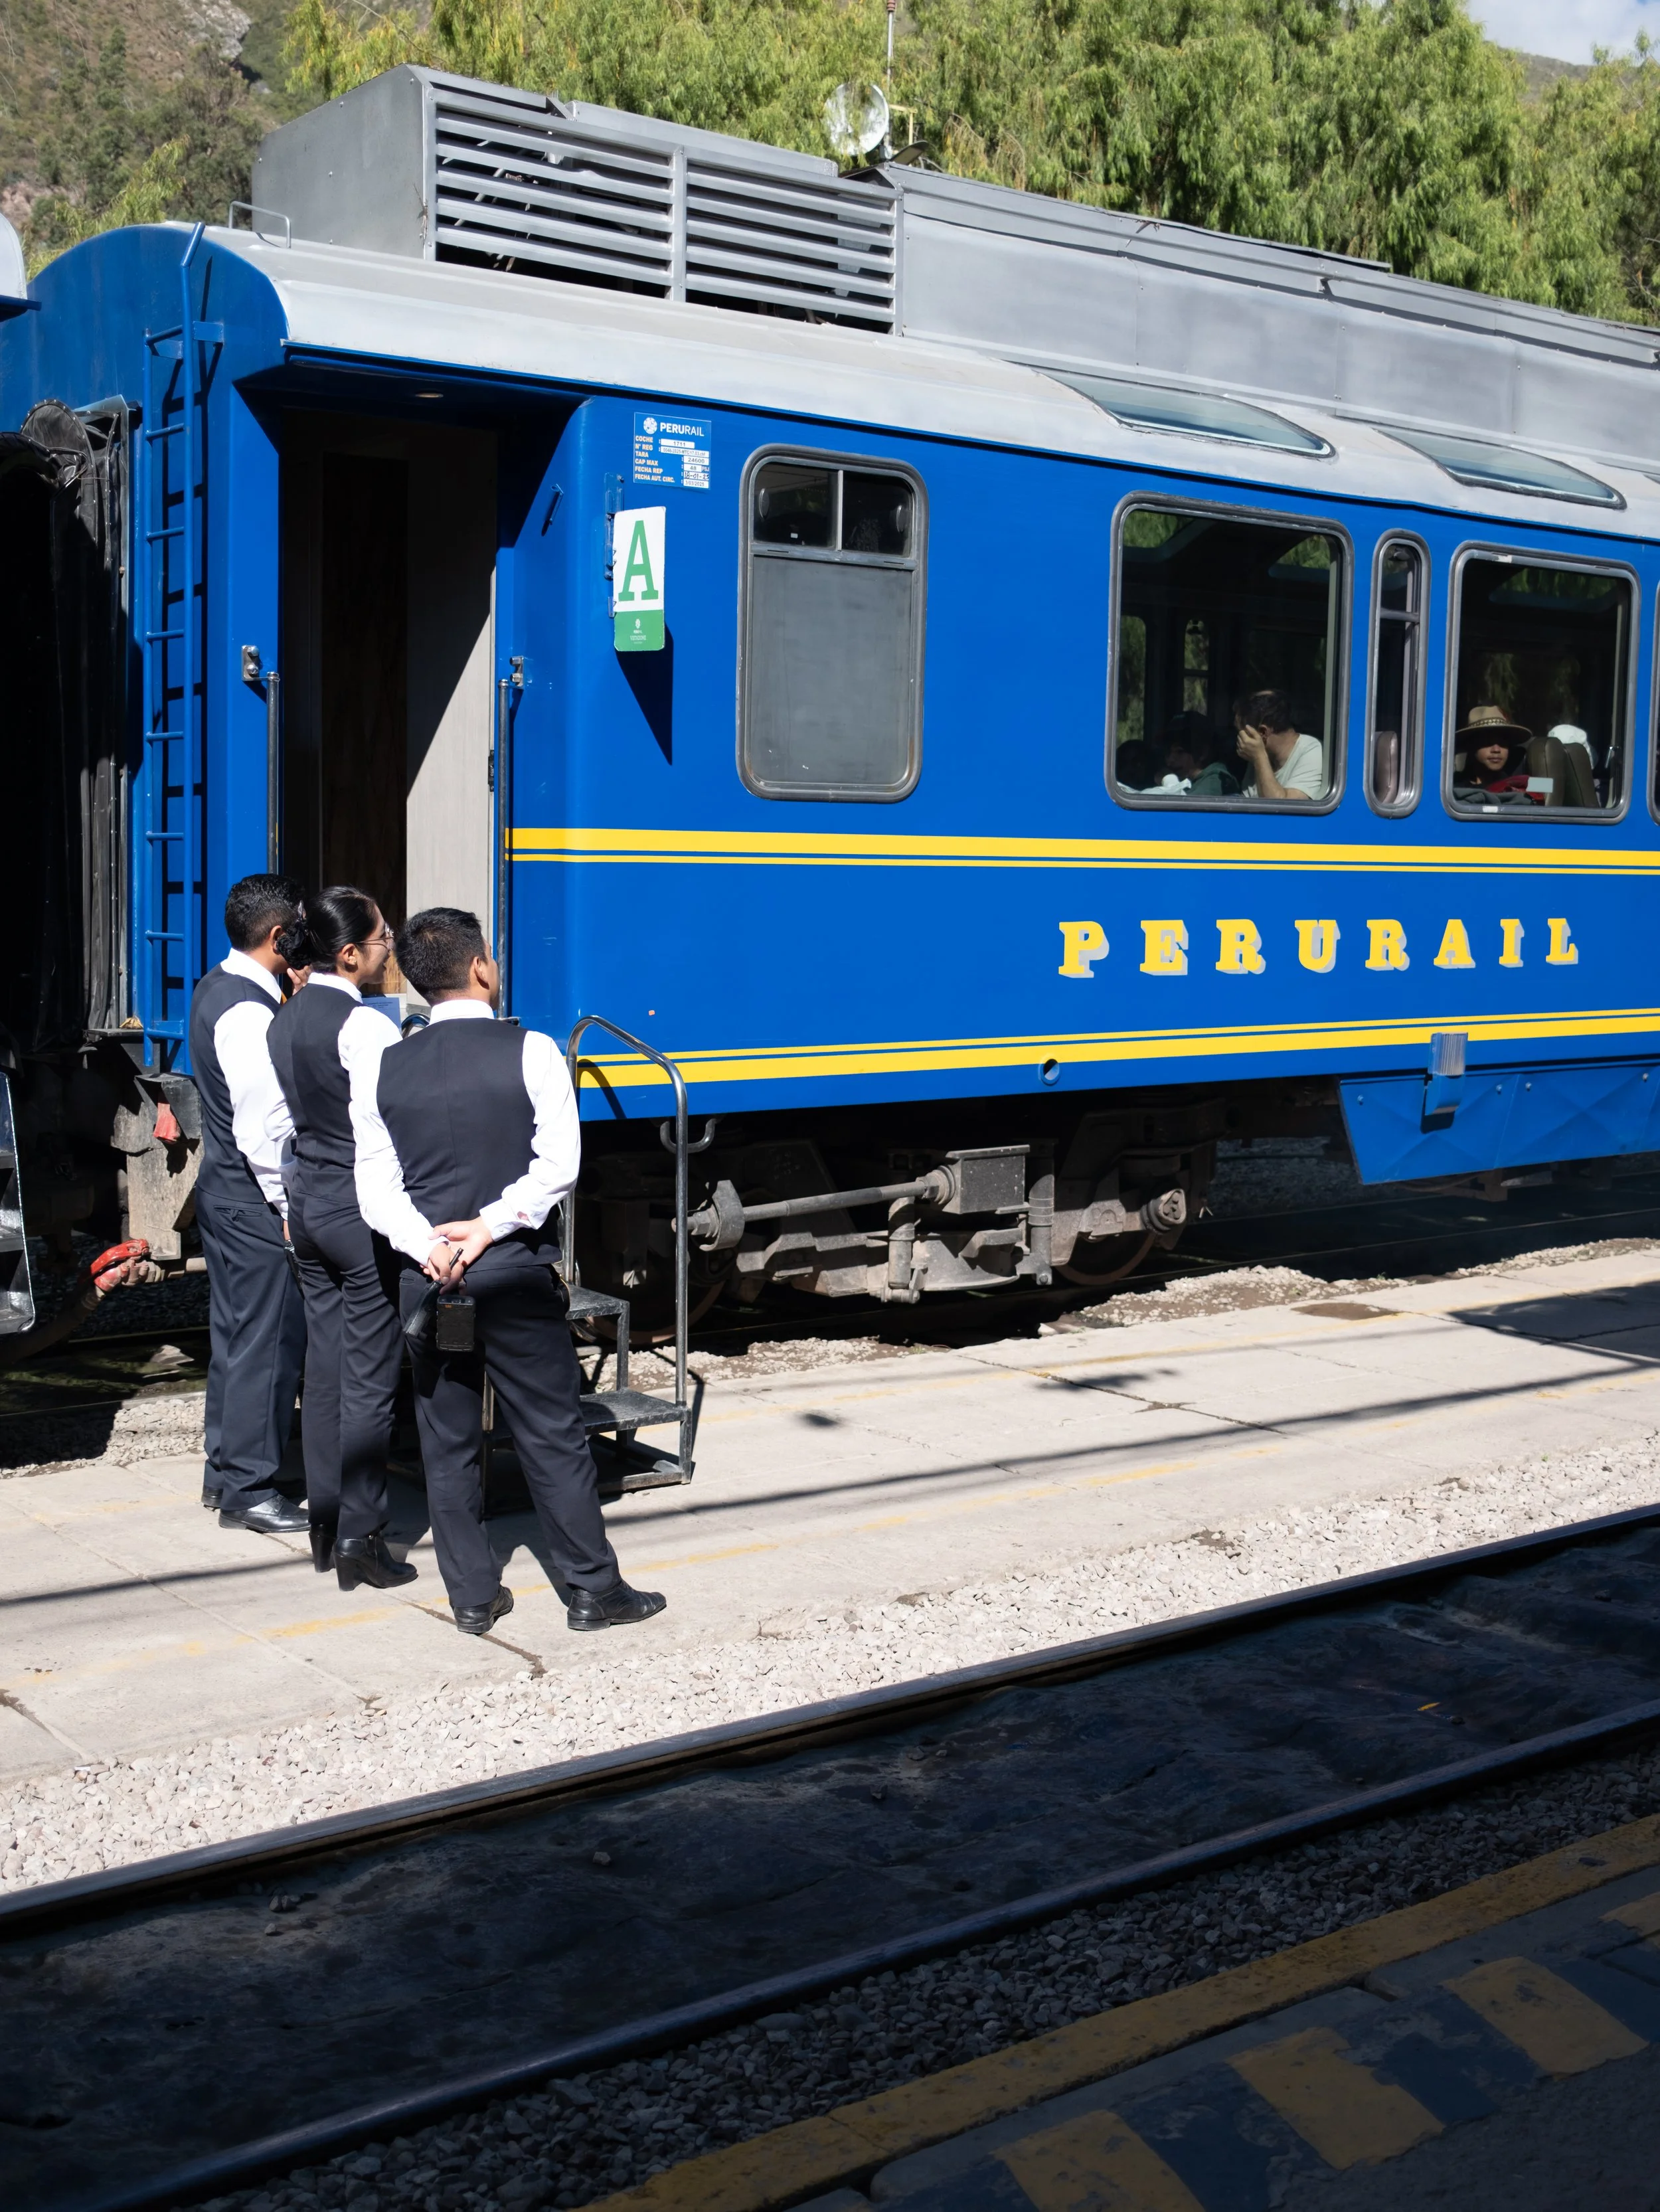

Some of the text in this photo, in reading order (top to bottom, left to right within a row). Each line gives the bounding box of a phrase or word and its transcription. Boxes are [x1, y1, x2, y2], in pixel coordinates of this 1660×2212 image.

[660, 422, 704, 436] PERURAIL
[618, 520, 659, 601] A
[1058, 917, 1579, 979] PERURAIL
